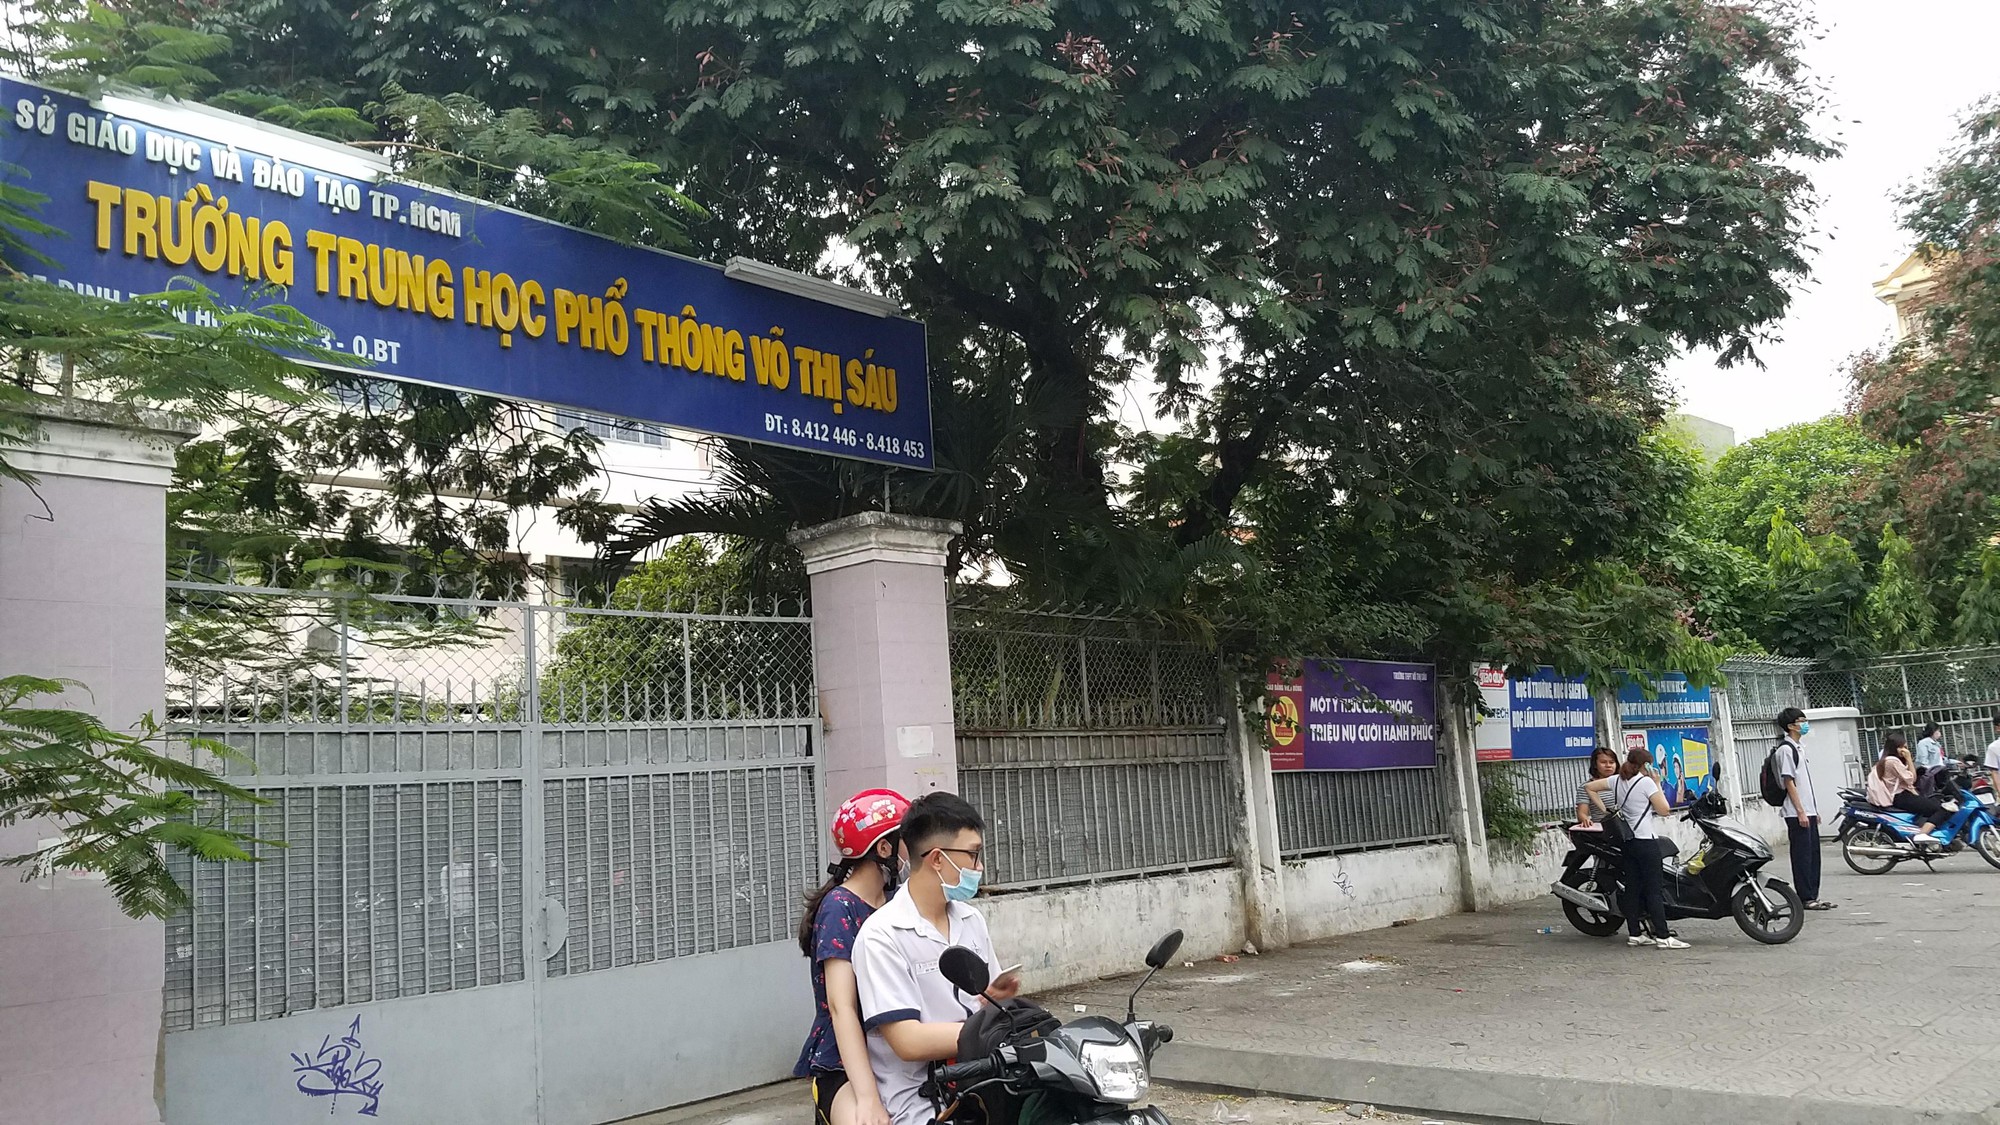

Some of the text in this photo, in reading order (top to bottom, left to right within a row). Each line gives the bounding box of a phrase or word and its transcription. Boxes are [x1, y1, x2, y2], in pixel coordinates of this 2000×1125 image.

[16, 94, 461, 238] SỞ GIÁO DỤC VÀ ĐÀO TẠO TP.HCM
[87, 182, 294, 286] TRƯỜNG
[306, 229, 455, 320] TRUNG
[463, 266, 546, 348] HỌC
[553, 277, 629, 356] PHỔ
[634, 304, 746, 382] THÔNG
[749, 325, 791, 390] VÕ
[794, 345, 843, 414] THỊ
[845, 348, 898, 414] SÁU
[765, 412, 788, 435] ĐT:
[791, 418, 830, 442] 8.412
[832, 426, 857, 446] 446
[866, 433, 900, 455] 8.418
[903, 439, 925, 459] 453
[1310, 696, 1332, 714] MỘT
[1332, 696, 1339, 712] Ý
[1310, 722, 1340, 744] TRIỆU
[1342, 724, 1356, 743] NỤ
[1358, 722, 1381, 742] CƯỜI
[1383, 724, 1409, 743] HẠNH
[1411, 722, 1433, 741] PHÚC
